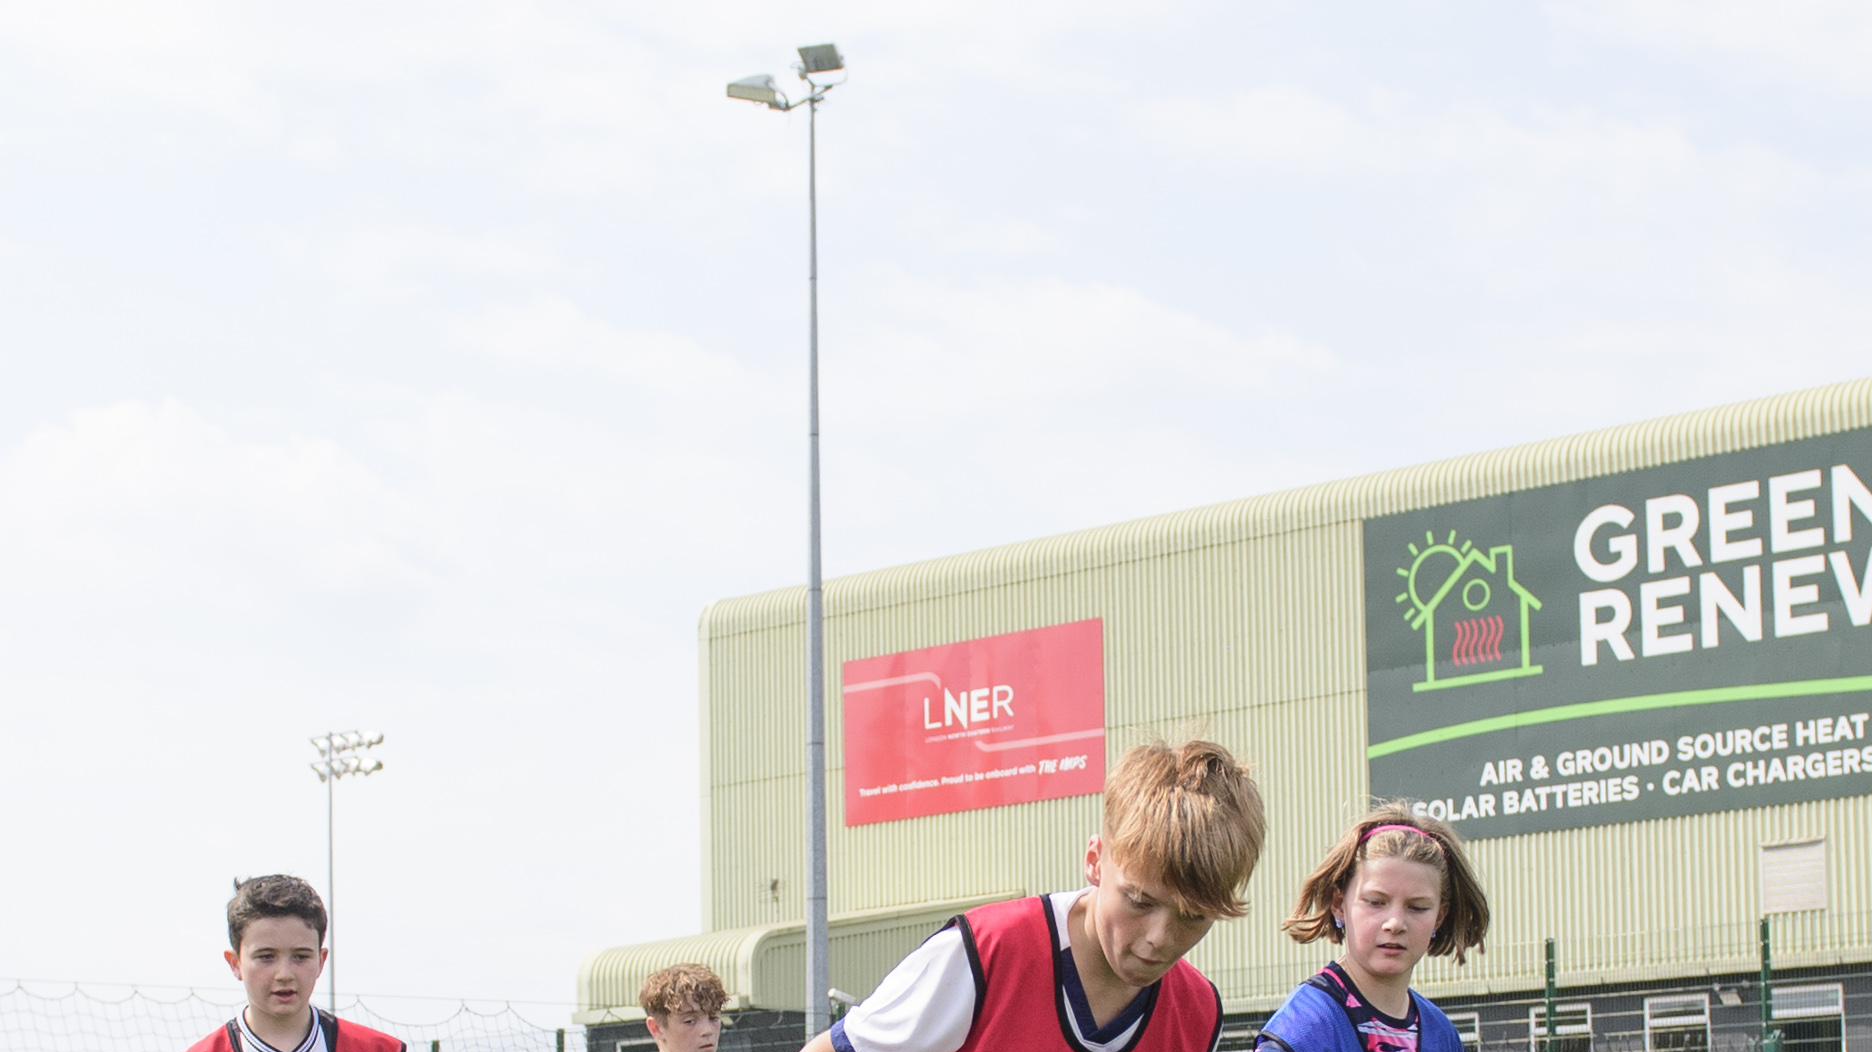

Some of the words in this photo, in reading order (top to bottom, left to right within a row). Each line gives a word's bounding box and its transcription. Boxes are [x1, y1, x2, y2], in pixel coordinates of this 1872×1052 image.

[923, 685, 1014, 730] LNER
[1479, 759, 1523, 787] AIR
[1530, 755, 1550, 780] &
[1557, 740, 1670, 777] GROUND
[1677, 724, 1788, 761] SOURCE
[1796, 713, 1869, 746] HEAT
[1502, 776, 1640, 815] BATTERIES
[1662, 766, 1719, 796] CAR
